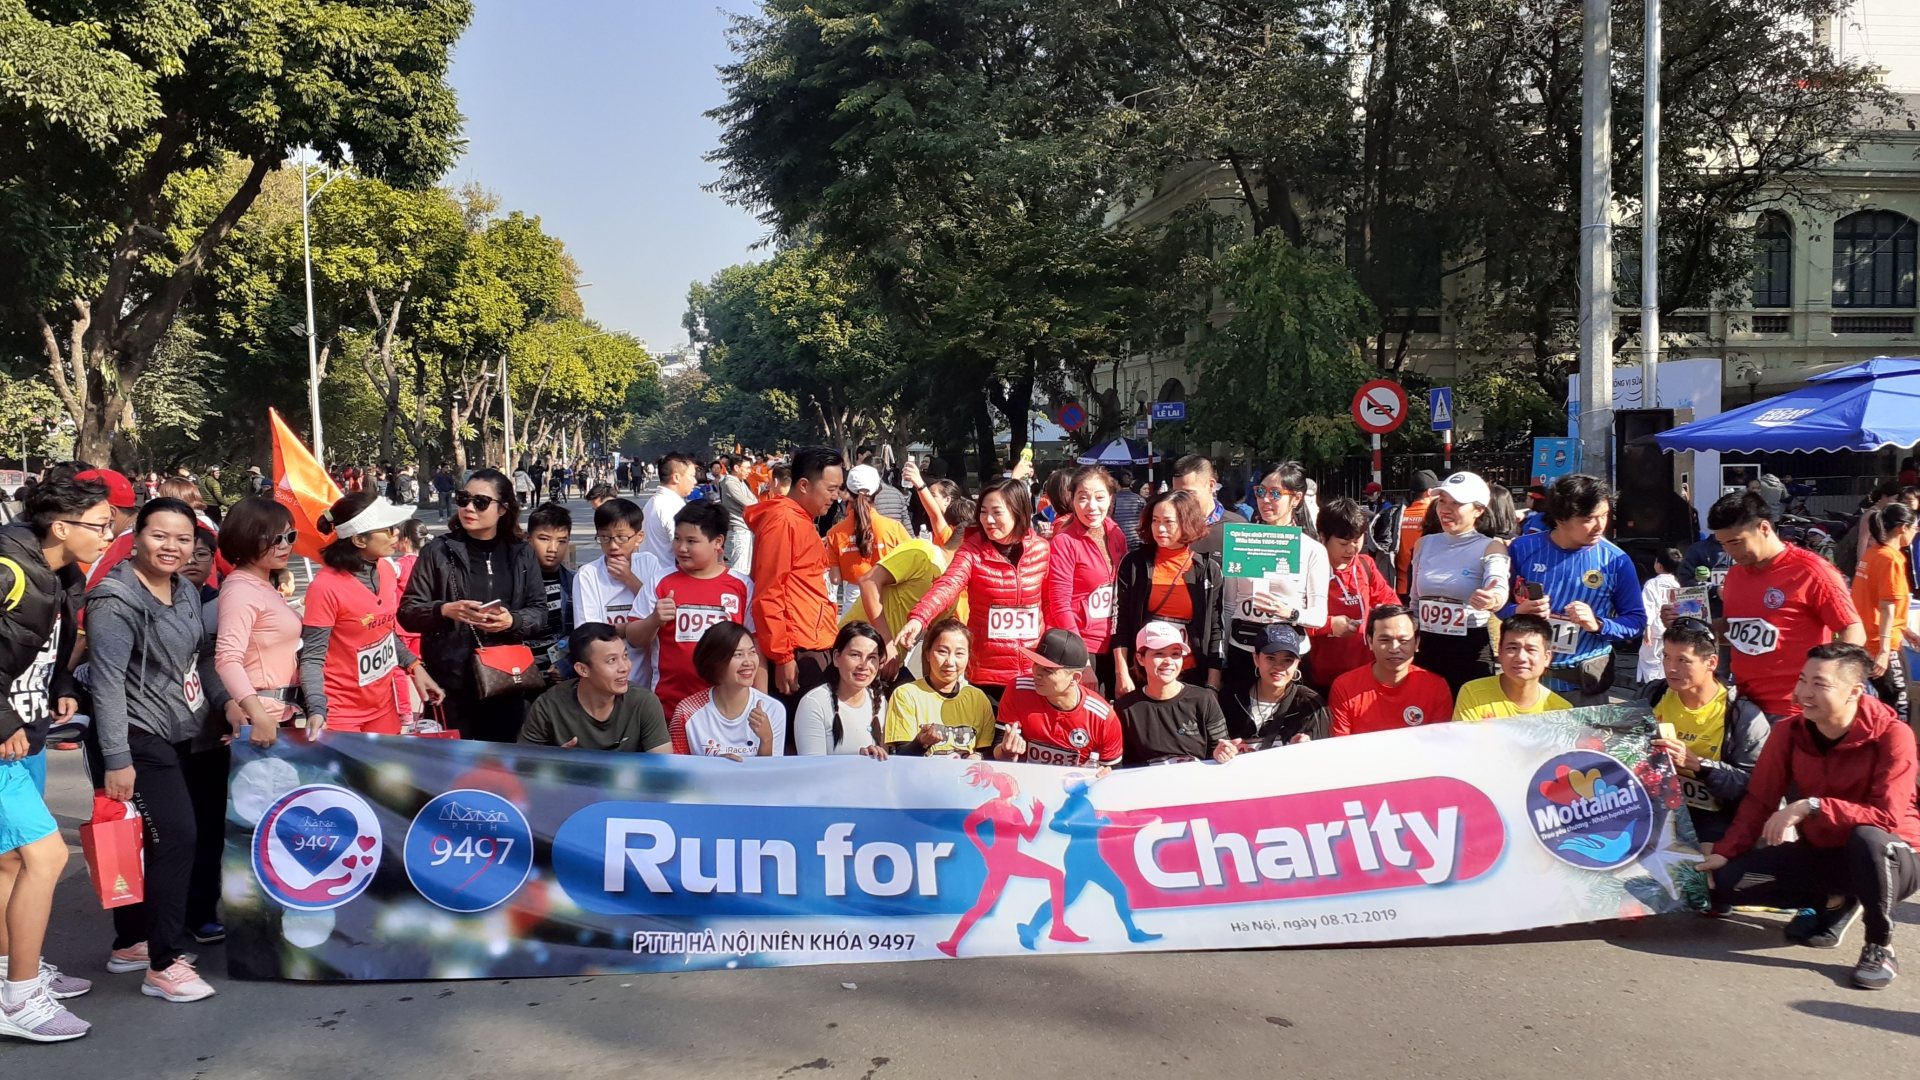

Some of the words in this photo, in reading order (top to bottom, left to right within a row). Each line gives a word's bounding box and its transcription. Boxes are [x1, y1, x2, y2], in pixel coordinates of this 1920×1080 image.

[1157, 409, 1166, 417] LÊ
[1168, 409, 1180, 417] LAI
[275, 490, 293, 503] Solid
[723, 597, 737, 609] 24
[991, 611, 1034, 629] 0951
[1421, 604, 1465, 626] 0992
[1730, 621, 1776, 648] 0620
[360, 638, 394, 675] 0606
[725, 746, 758, 754] iRace.vn
[1029, 747, 1077, 766] 0983
[1534, 779, 1640, 832] Mottainai
[143, 811, 160, 844] VELOCE
[452, 823, 498, 832] PTTH
[293, 834, 339, 851] 9497
[430, 835, 515, 866] 9497
[1133, 798, 1459, 885] Charity
[604, 817, 797, 895] Run
[817, 822, 955, 896] for
[1230, 921, 1250, 932] Hà
[1252, 918, 1281, 932] Nội,
[1283, 916, 1317, 931] ngày
[1320, 908, 1398, 926] 08.12.2019
[634, 931, 684, 952] PTTH
[687, 928, 717, 952] HÀ
[721, 930, 755, 954] NỘI
[760, 930, 805, 951] NIÊN
[810, 931, 863, 951] KHÓA
[867, 934, 916, 951] 9497
